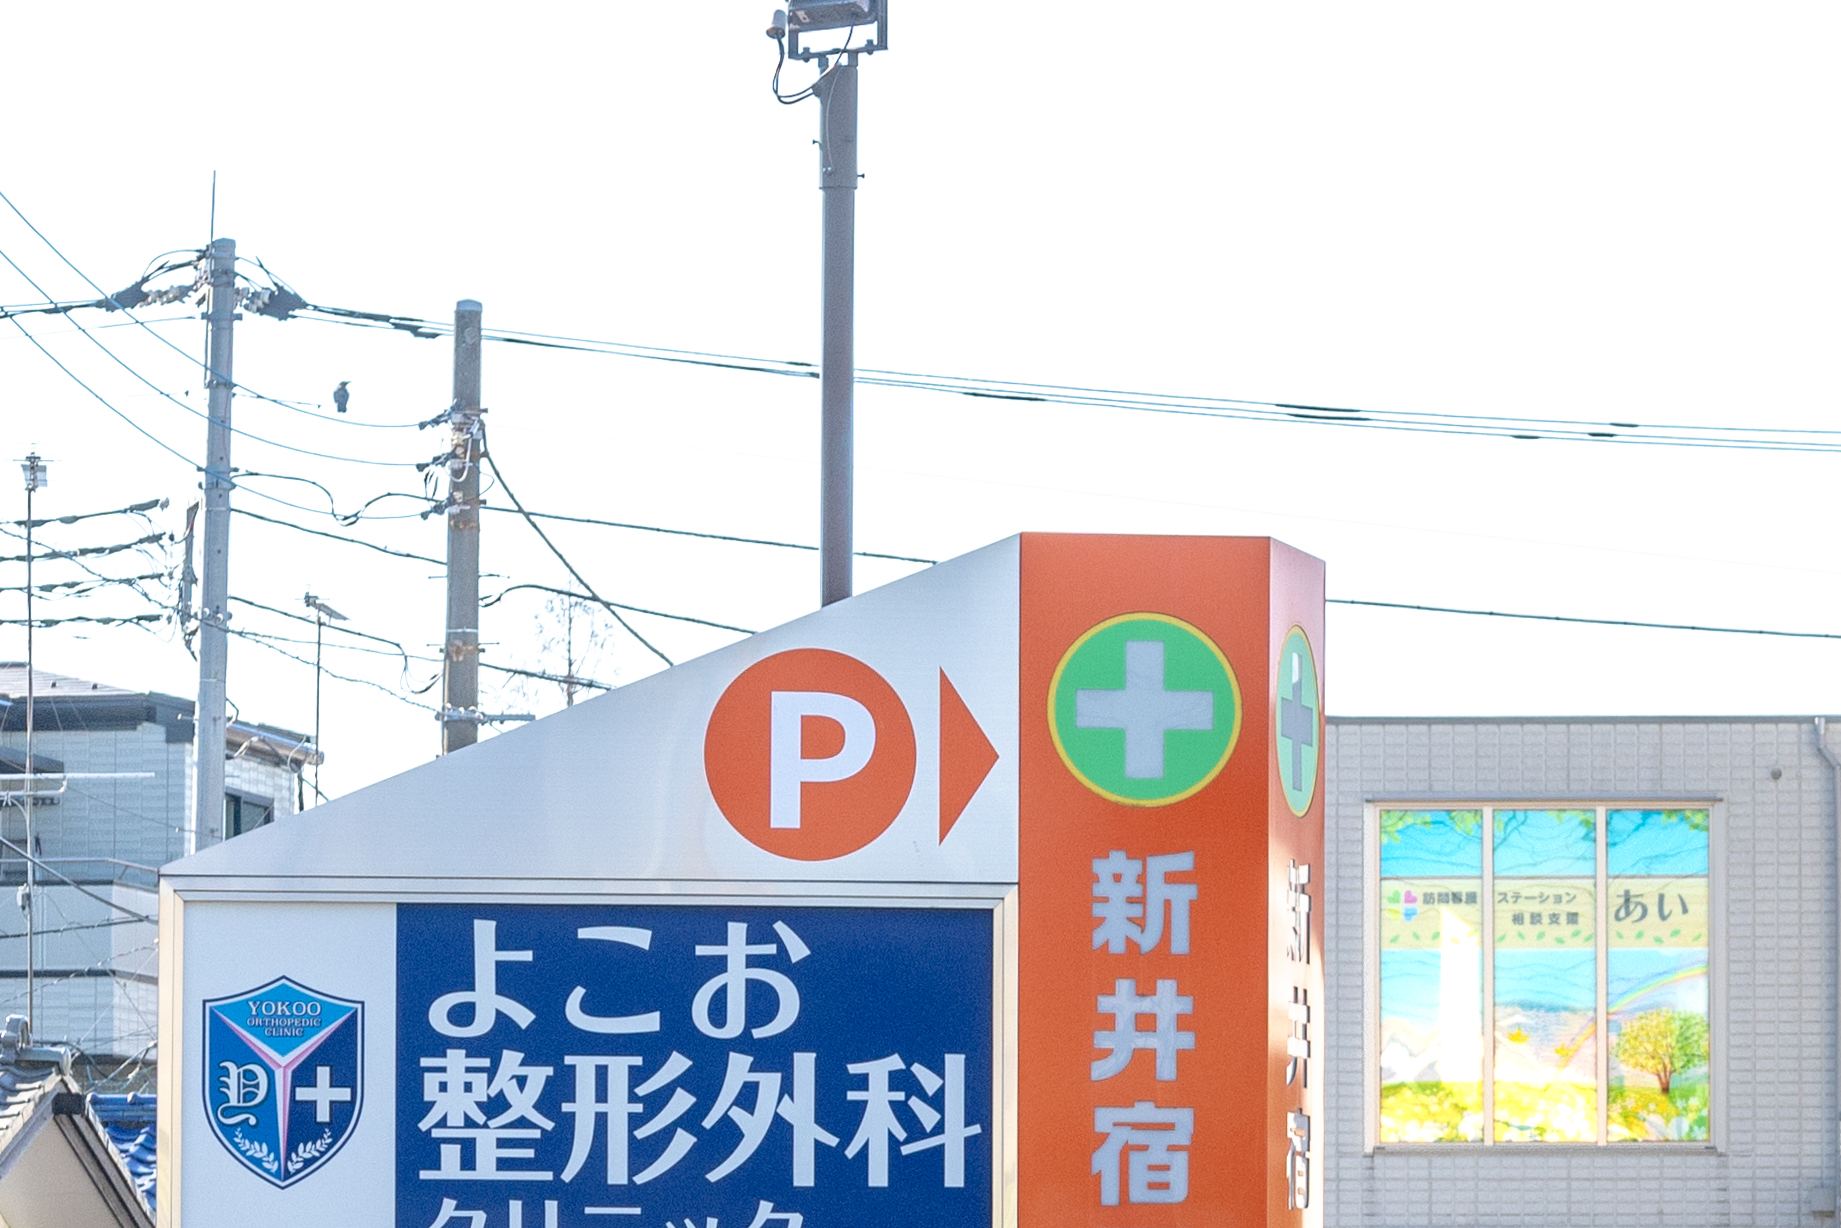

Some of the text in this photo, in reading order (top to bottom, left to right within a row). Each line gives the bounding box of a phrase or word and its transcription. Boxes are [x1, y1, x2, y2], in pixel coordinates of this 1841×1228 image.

[770, 691, 877, 829] P
[1613, 889, 1689, 923] あい
[428, 919, 811, 1039] よこお
[246, 1017, 321, 1027] ORTHOPEDIC
[247, 1000, 321, 1016] YOKOO
[264, 1027, 304, 1037] CLINIC
[418, 1050, 982, 1188] 整形外科
